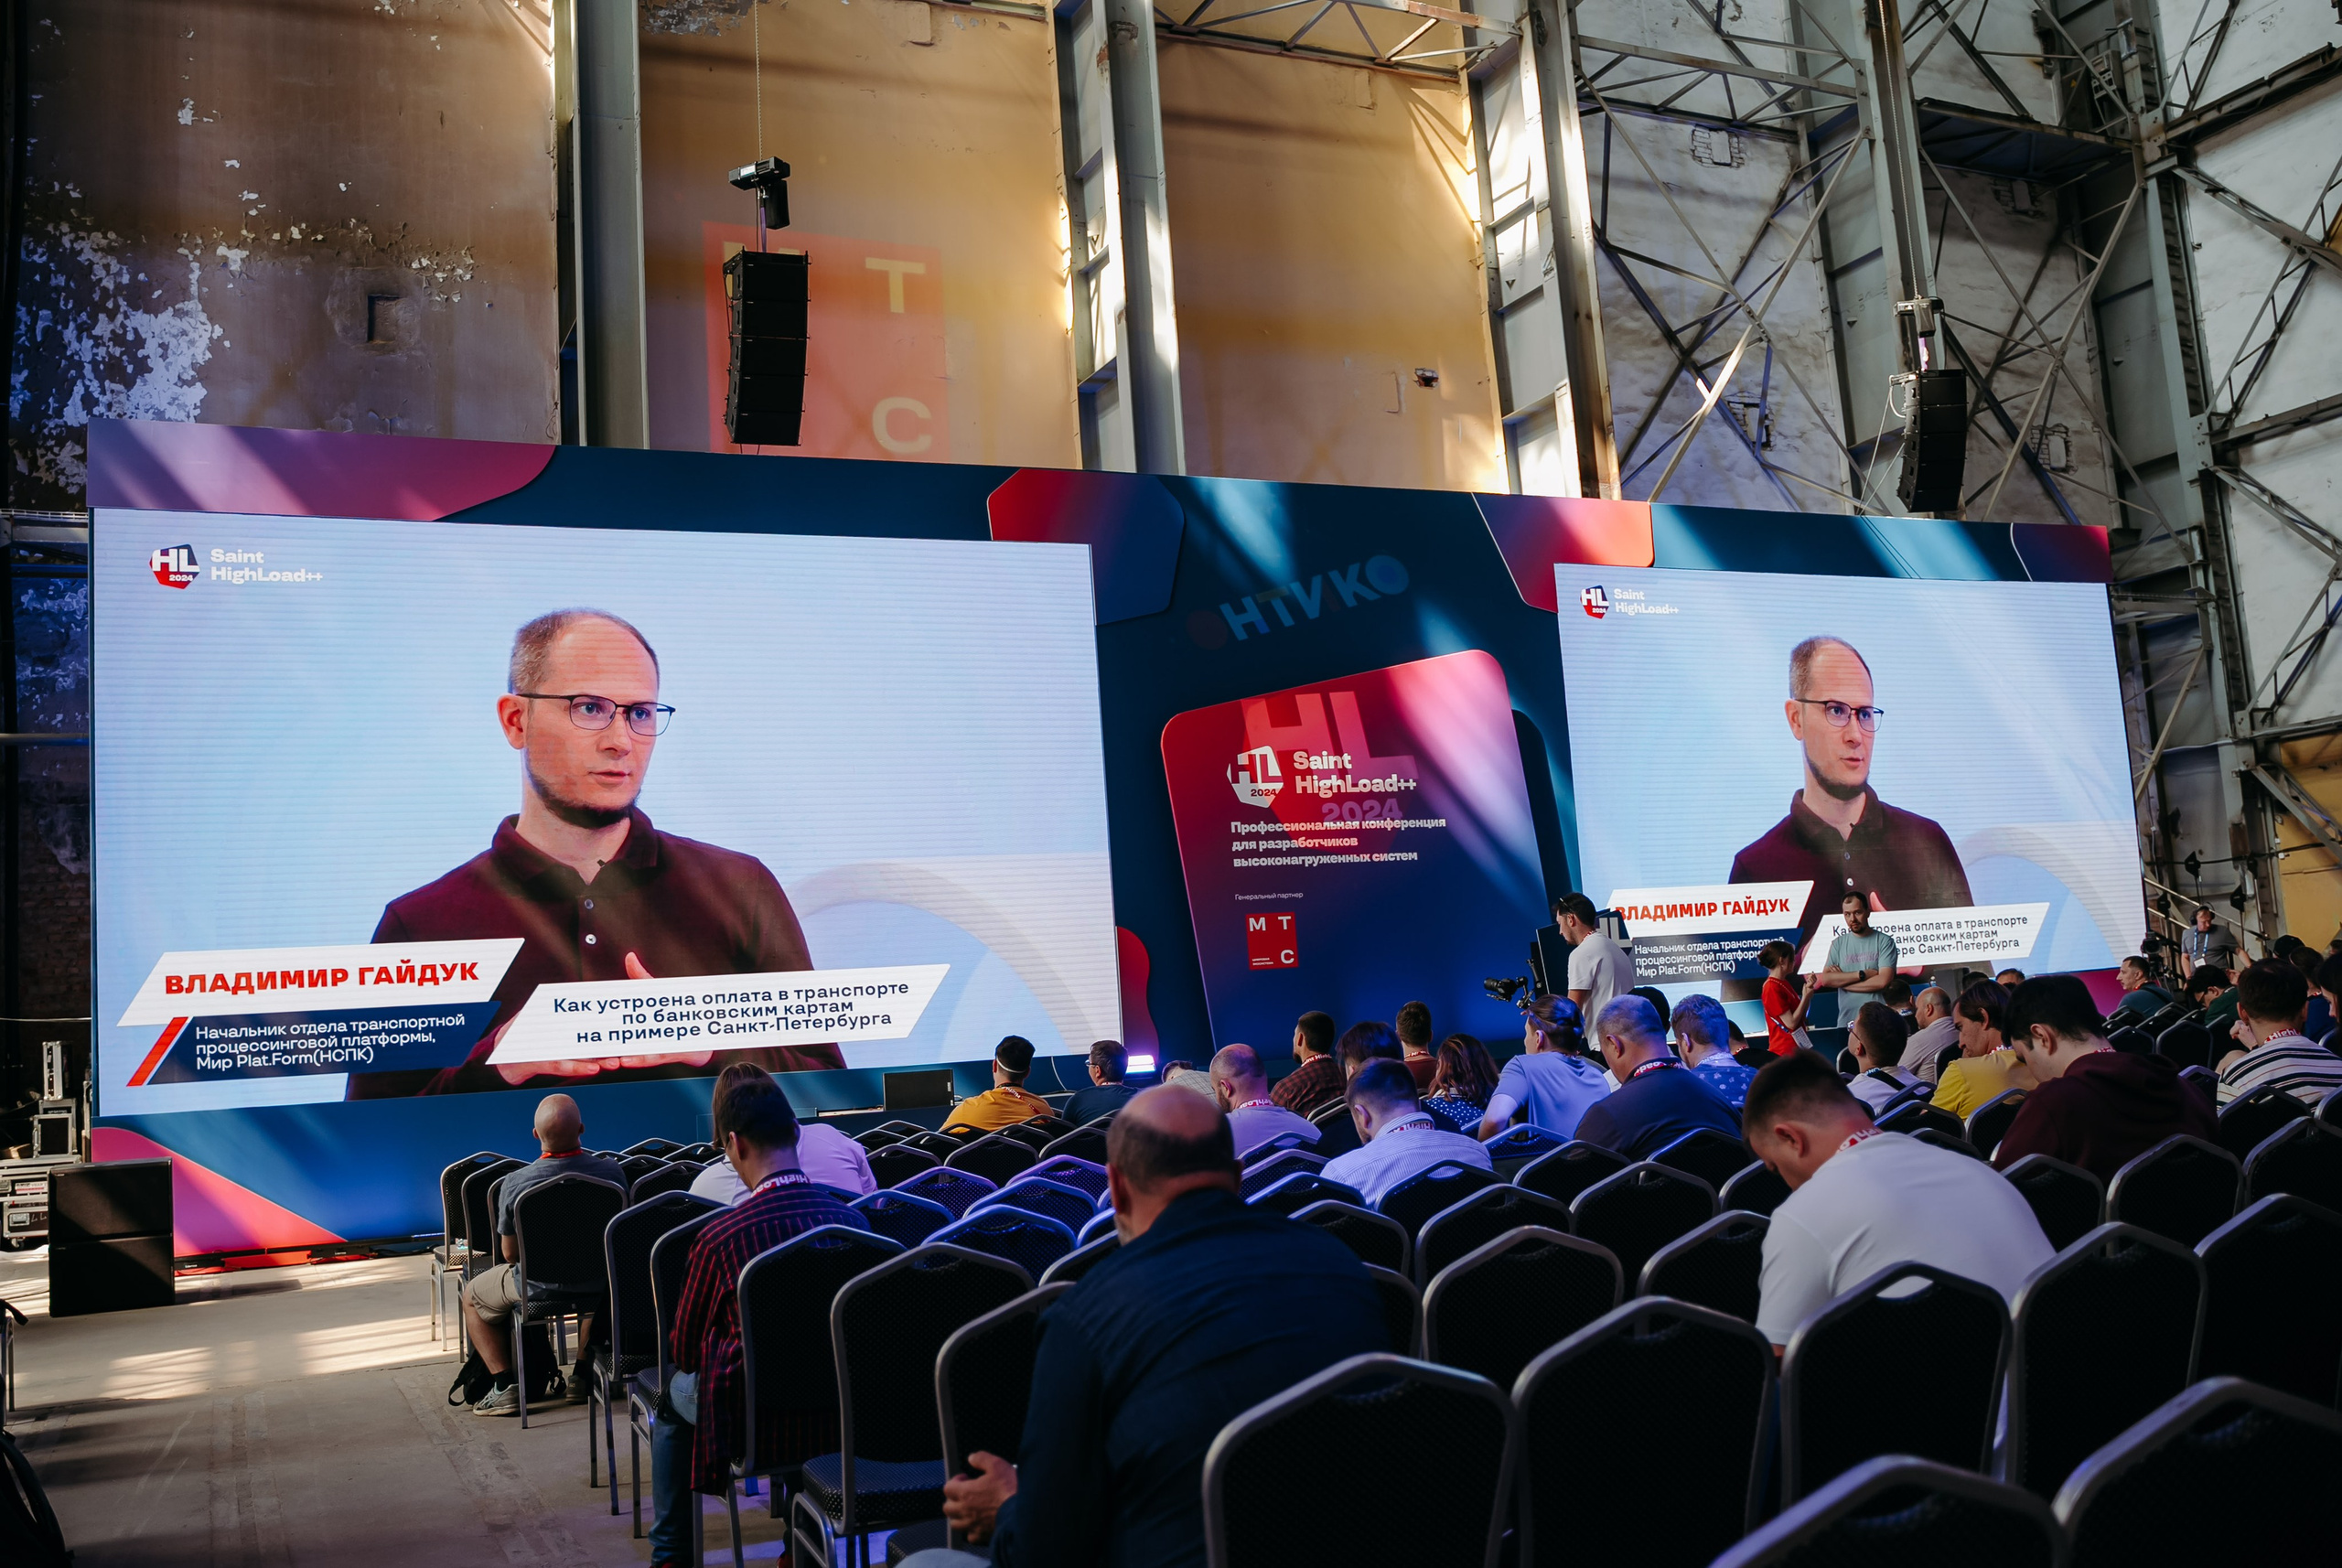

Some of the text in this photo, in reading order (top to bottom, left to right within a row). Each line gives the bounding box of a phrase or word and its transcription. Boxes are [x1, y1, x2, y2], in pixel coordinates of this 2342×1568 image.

[152, 549, 199, 572] HL
[210, 549, 264, 564] Saint
[211, 566, 323, 585] HighLoad++
[1581, 589, 1609, 606] HL
[1614, 588, 1645, 600] Saint
[1616, 603, 1680, 616] HighLoad++
[1294, 751, 1352, 769] Saint
[1251, 789, 1277, 797] 2024
[1295, 774, 1417, 799] HighLoad++
[1230, 817, 1446, 834] Профессиональная конференция
[1232, 836, 1359, 852] для разработчиков
[1233, 851, 1418, 867] высоконагруженных систем
[1235, 893, 1276, 901] Генеральный
[1616, 896, 1790, 921] ВЛАДИМИР ГАЙДУК
[1914, 920, 1953, 931] оплата
[1956, 920, 1962, 929] в
[1964, 917, 2028, 929] транспорте
[1891, 929, 1998, 945] анковским картам
[1635, 937, 1785, 955] Начальник отдела транспорт
[1918, 939, 2020, 954] Санкт-Петербурга
[1636, 952, 1714, 966] процессинговой
[166, 959, 479, 994] ВЛАДИМИР ГАЙДУК
[1636, 961, 1736, 978] Мир Plat.Form(НСПК)
[554, 983, 909, 1013] Как устроена оплата в транспорте
[623, 1001, 854, 1025] по банковским картам
[196, 1014, 465, 1039] Начальник отдела транспортной
[577, 1011, 892, 1044] на примере Санкт-Петербурга
[197, 1031, 435, 1055] процессинговой платформы,
[197, 1047, 373, 1072] Мир Plat.Form(НСПК)
